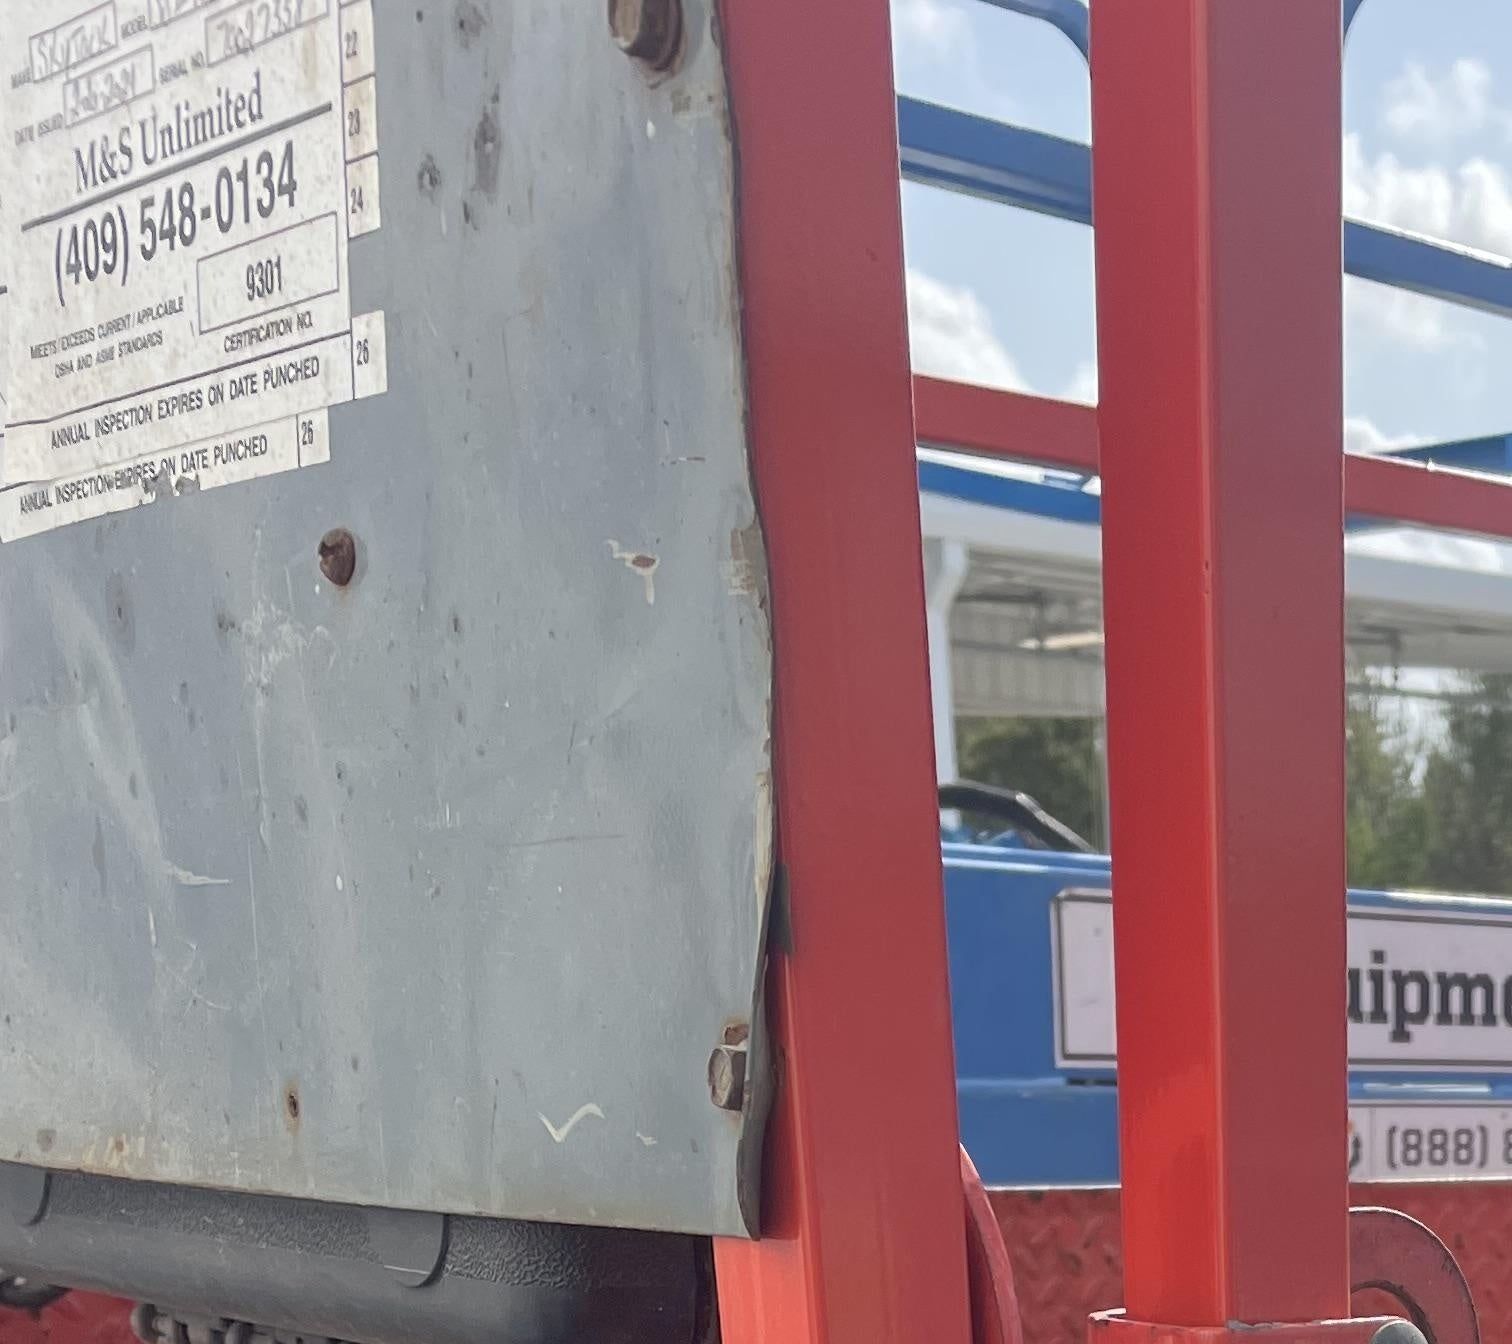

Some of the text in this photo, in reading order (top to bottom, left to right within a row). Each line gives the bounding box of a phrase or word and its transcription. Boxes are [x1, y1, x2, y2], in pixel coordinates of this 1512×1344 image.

[345, 30, 357, 59] 22
[75, 126, 132, 193] M&S
[139, 67, 263, 165] Unlimited
[348, 109, 360, 136] 23
[351, 186, 363, 213] 24
[55, 140, 297, 306] (409) 548-0134
[246, 255, 282, 300] 9301
[224, 315, 292, 352] CERTIFICATION
[356, 338, 369, 365] 26
[51, 356, 320, 450] ANNUAL INSPECTION EXPIRES ON DATE PUNCHED
[301, 420, 313, 445] 26
[20, 488, 52, 515] ANNUAL
[55, 475, 113, 504] INSPECTION
[181, 449, 208, 473] DATE
[214, 435, 267, 466] PUNCHED
[1386, 1124, 1488, 1169] (888)
